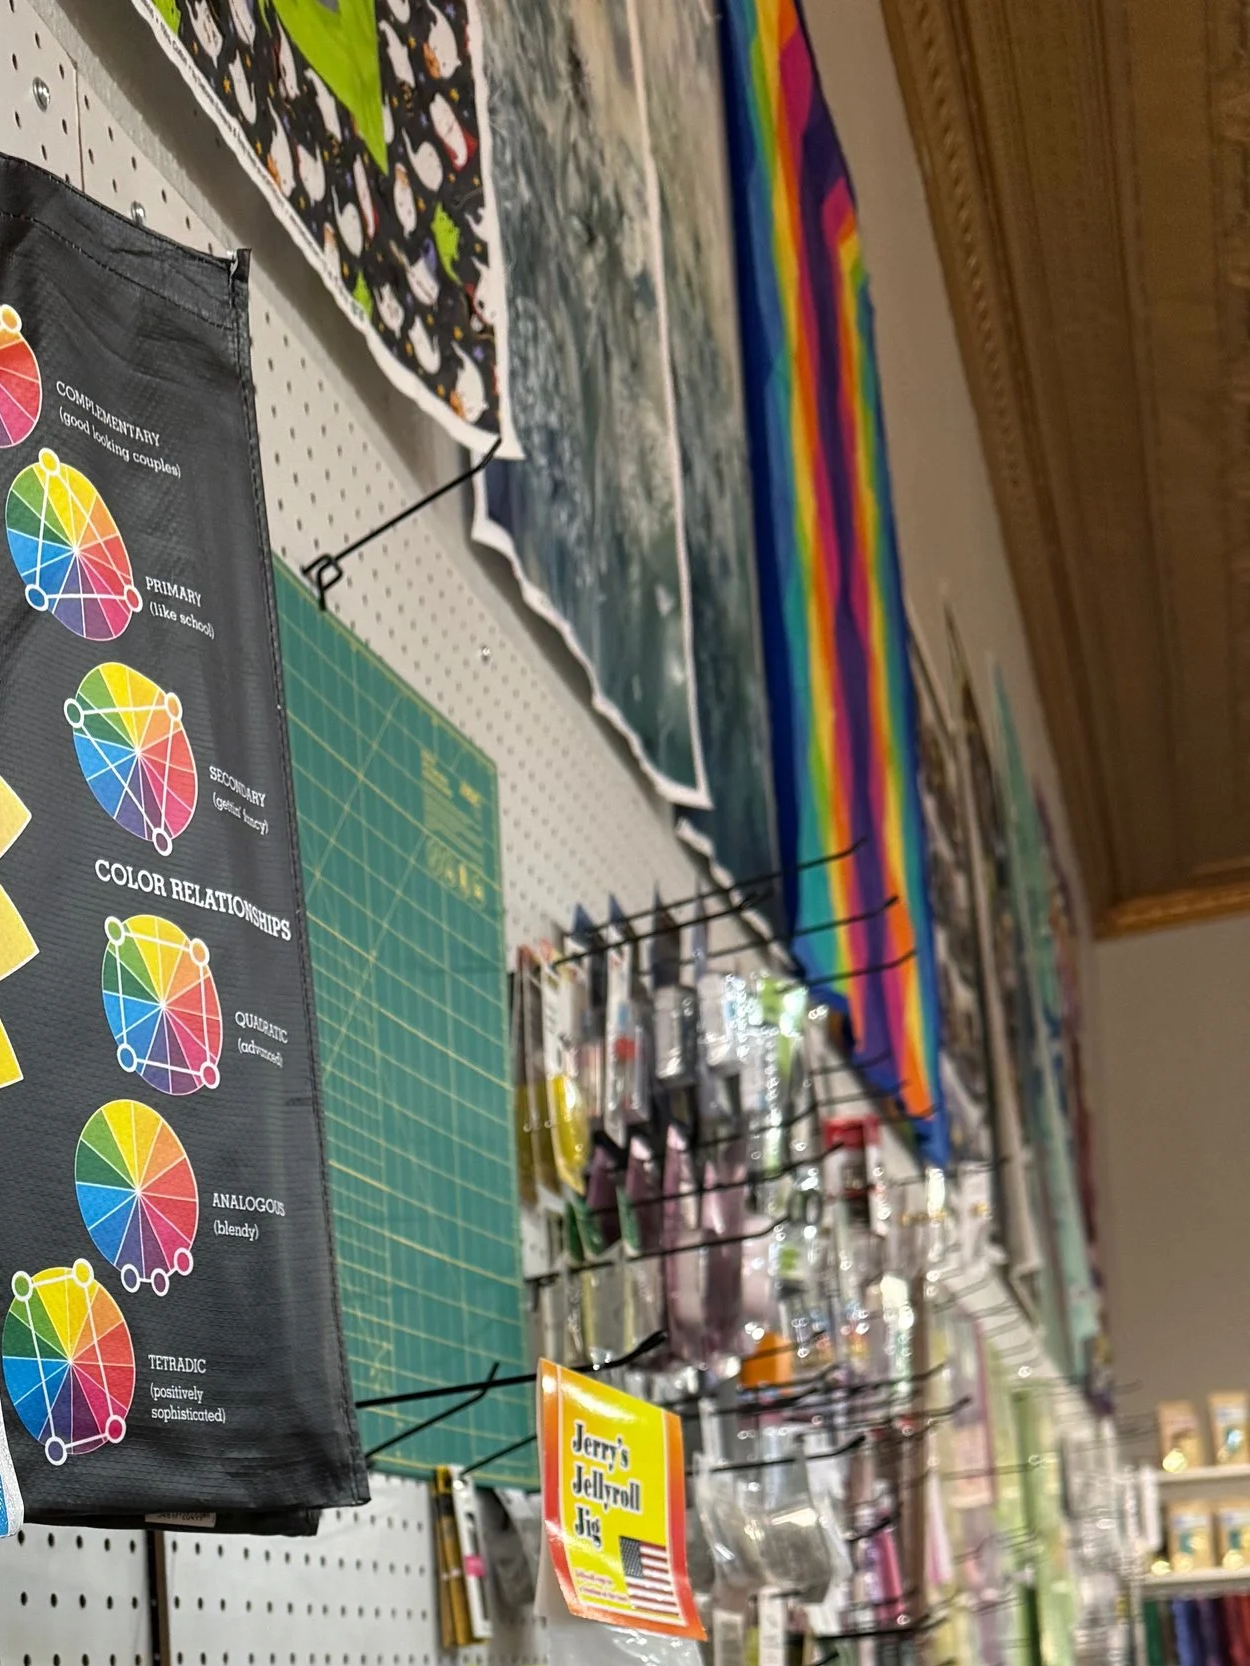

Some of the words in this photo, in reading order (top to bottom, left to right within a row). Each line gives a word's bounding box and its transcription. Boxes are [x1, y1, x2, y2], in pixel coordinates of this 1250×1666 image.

[56, 380, 160, 447] COMPLEMENTARY
[59, 406, 91, 436] (good
[91, 424, 130, 462] looking
[132, 452, 181, 479] couples)
[145, 576, 202, 607] PRIMARY
[149, 601, 177, 622] (like
[179, 612, 215, 640] school)
[209, 766, 266, 807] SECONDARY
[95, 860, 167, 897] COLOR
[170, 878, 292, 941] RELATIONSHIPS
[235, 1011, 289, 1044] QUADRATIC
[212, 1193, 286, 1217] ANALOGOUS
[213, 1220, 260, 1241] (blendy)
[148, 1354, 207, 1374] TETRADIC
[150, 1383, 203, 1404] (positively
[151, 1406, 226, 1423] sophisticated)
[573, 1422, 629, 1471] Jerry's
[573, 1464, 641, 1511] Jellyroll
[575, 1506, 601, 1547] Jig
